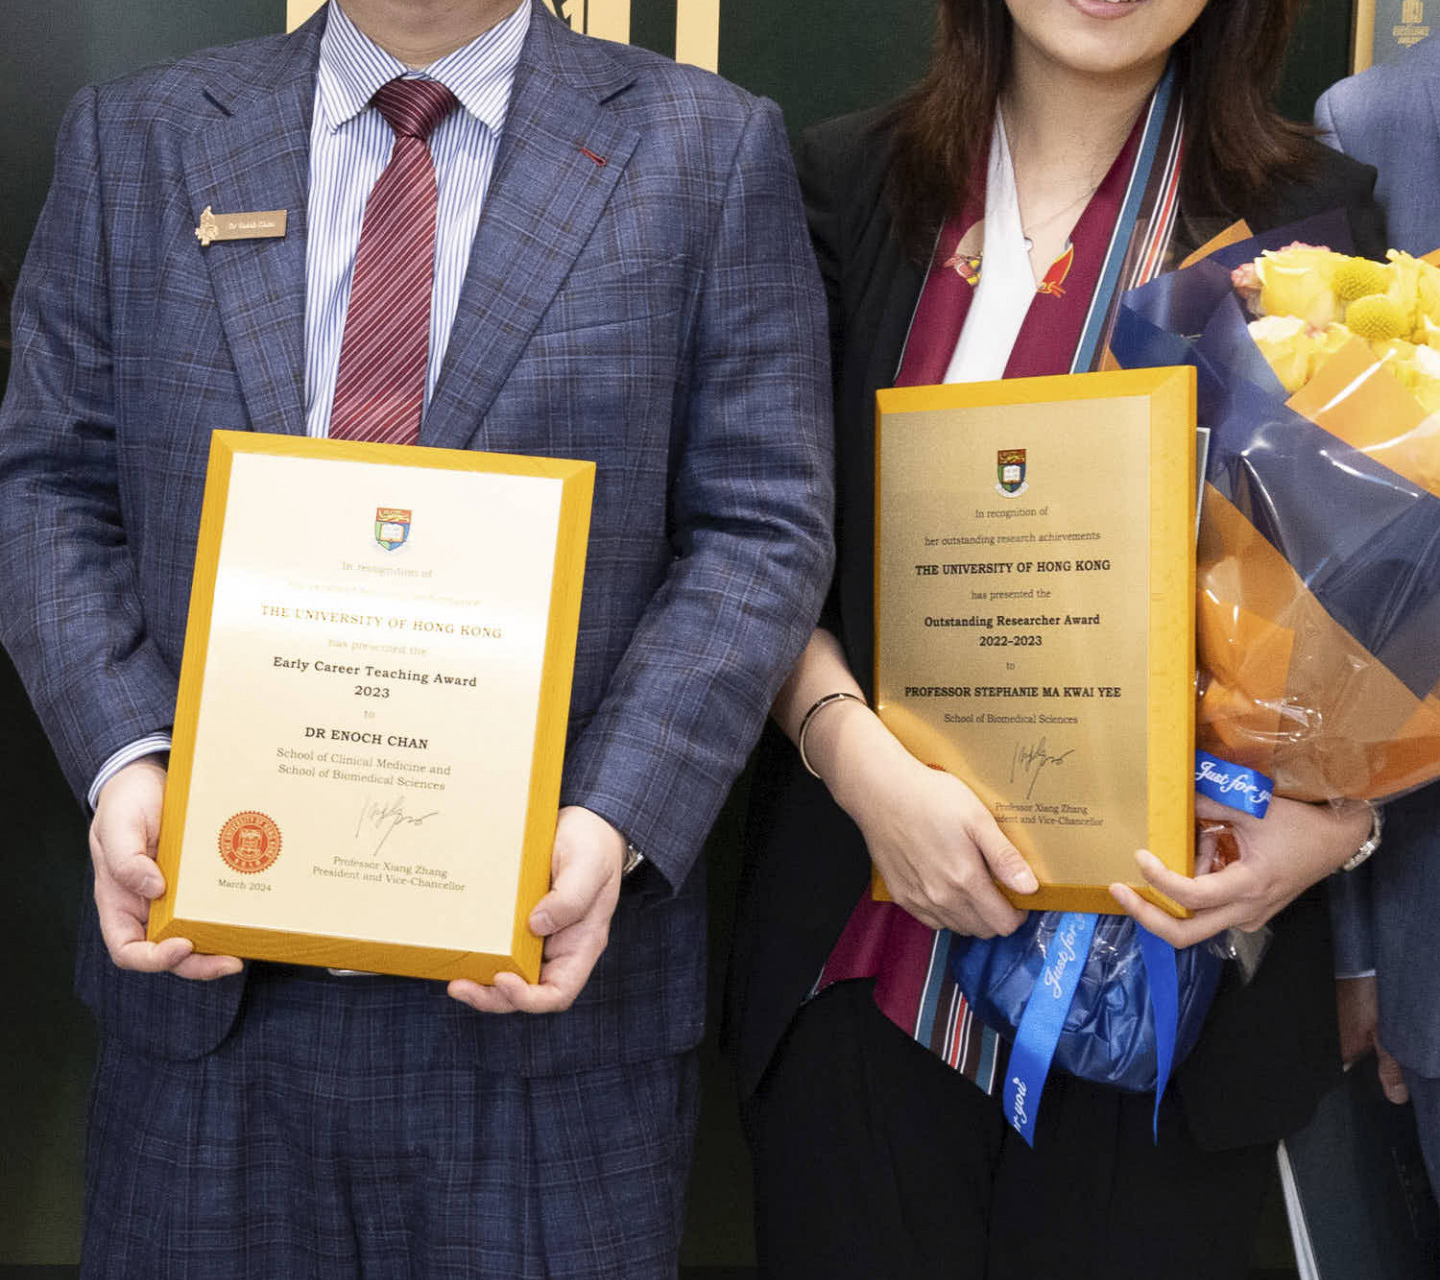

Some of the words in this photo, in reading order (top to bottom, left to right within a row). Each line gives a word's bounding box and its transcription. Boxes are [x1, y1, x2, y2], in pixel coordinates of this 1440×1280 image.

[915, 564, 939, 576] THE
[942, 562, 1013, 575] UNIVERSITY
[1016, 561, 1033, 573] OF
[1037, 560, 1071, 572] HONG
[1075, 559, 1111, 571] KONG
[261, 605, 290, 619] THE
[295, 608, 383, 627] UNIVERSITY
[387, 617, 407, 629] OF
[413, 620, 454, 634] HONG
[460, 624, 502, 639] KONG
[924, 615, 993, 629] Outstanding
[996, 615, 1061, 626] Researcher
[1064, 614, 1100, 625] Award
[273, 656, 310, 673] Early
[314, 660, 360, 675] Career
[365, 665, 429, 685] Teaching
[433, 673, 477, 687] Award
[354, 685, 390, 699] 2023
[905, 686, 971, 697] PROFESSOR
[974, 686, 1039, 697] STEPHANIE
[1042, 687, 1060, 697] MA
[1063, 686, 1094, 697] KWAI
[1097, 687, 1121, 698] YEE
[304, 726, 326, 739] DR
[330, 729, 382, 745] ENOCH
[387, 735, 428, 749] CHAN
[1195, 761, 1230, 785] Just
[1220, 774, 1259, 793] for
[1044, 950, 1069, 999] Just
[1060, 924, 1077, 962] for
